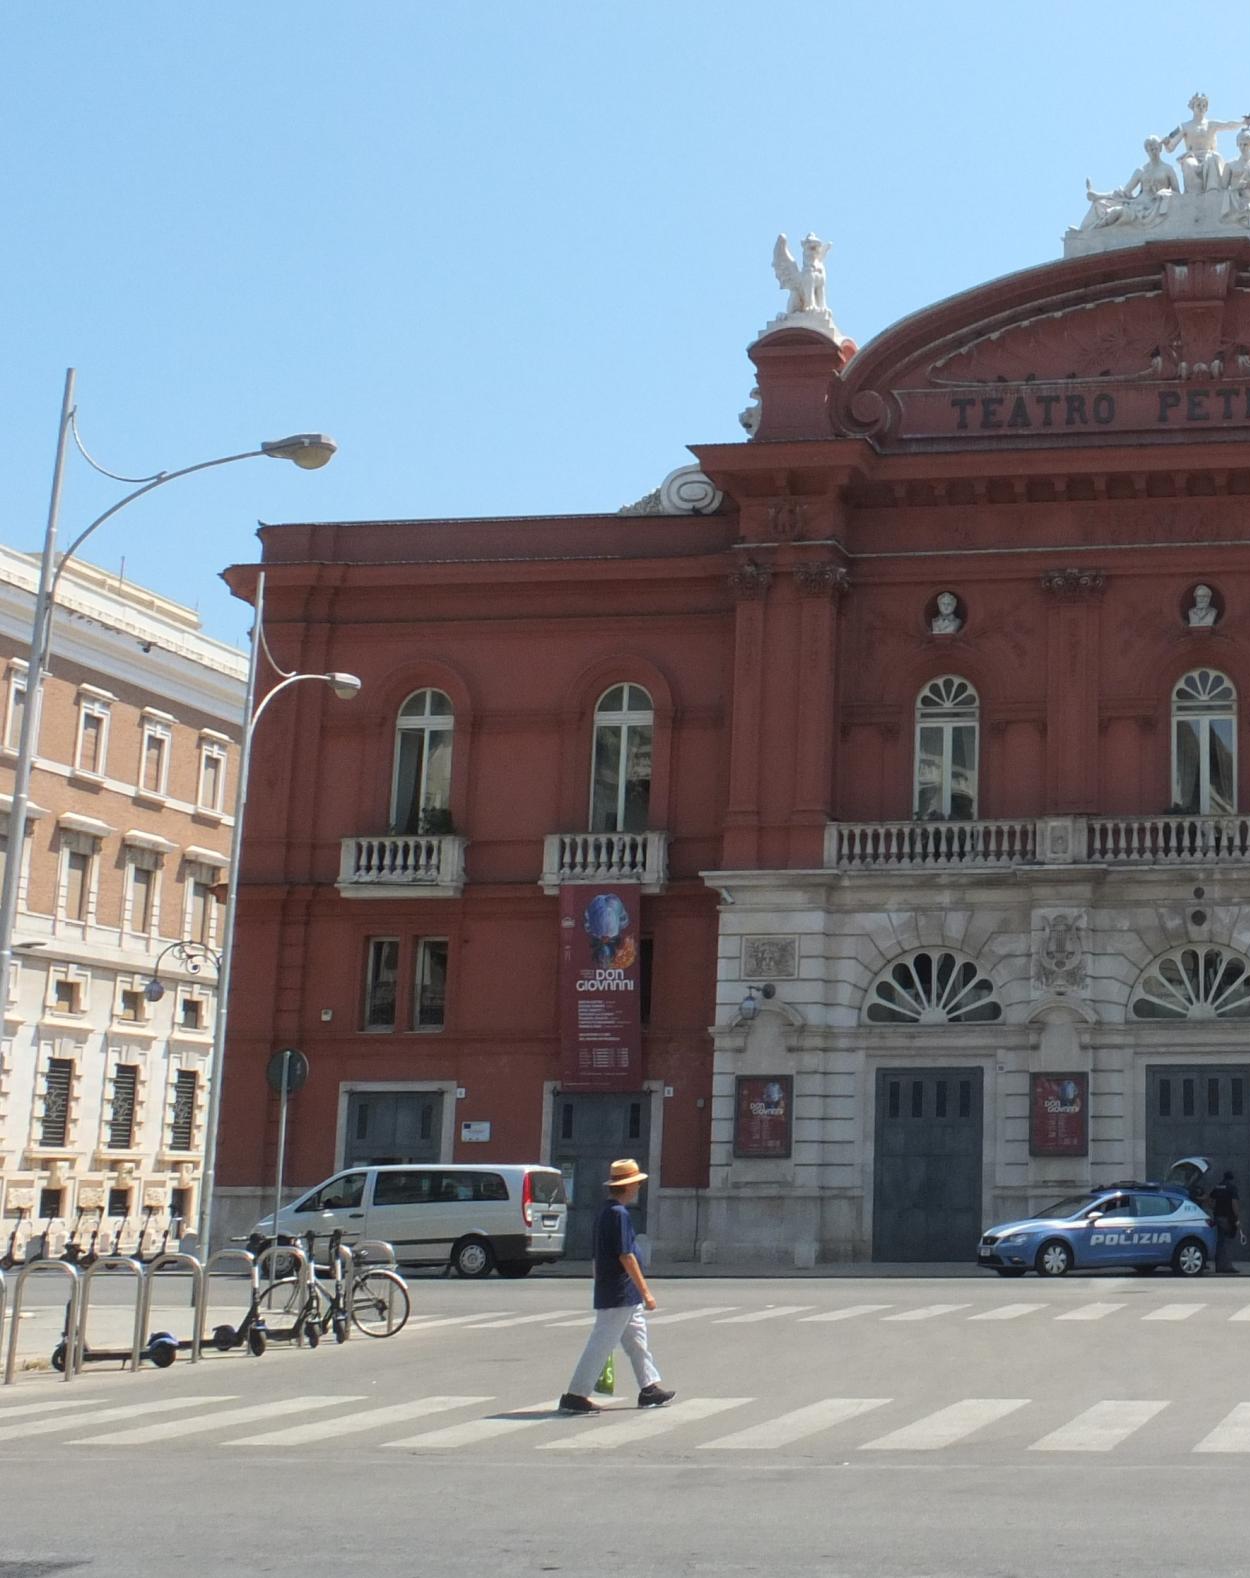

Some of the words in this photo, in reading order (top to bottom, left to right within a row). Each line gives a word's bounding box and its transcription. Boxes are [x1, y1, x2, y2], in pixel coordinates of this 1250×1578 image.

[951, 391, 1117, 430] TEATRO
[595, 969, 624, 980] DON
[576, 980, 634, 991] GIOVANNI
[1089, 1232, 1172, 1246] POLIZIA
